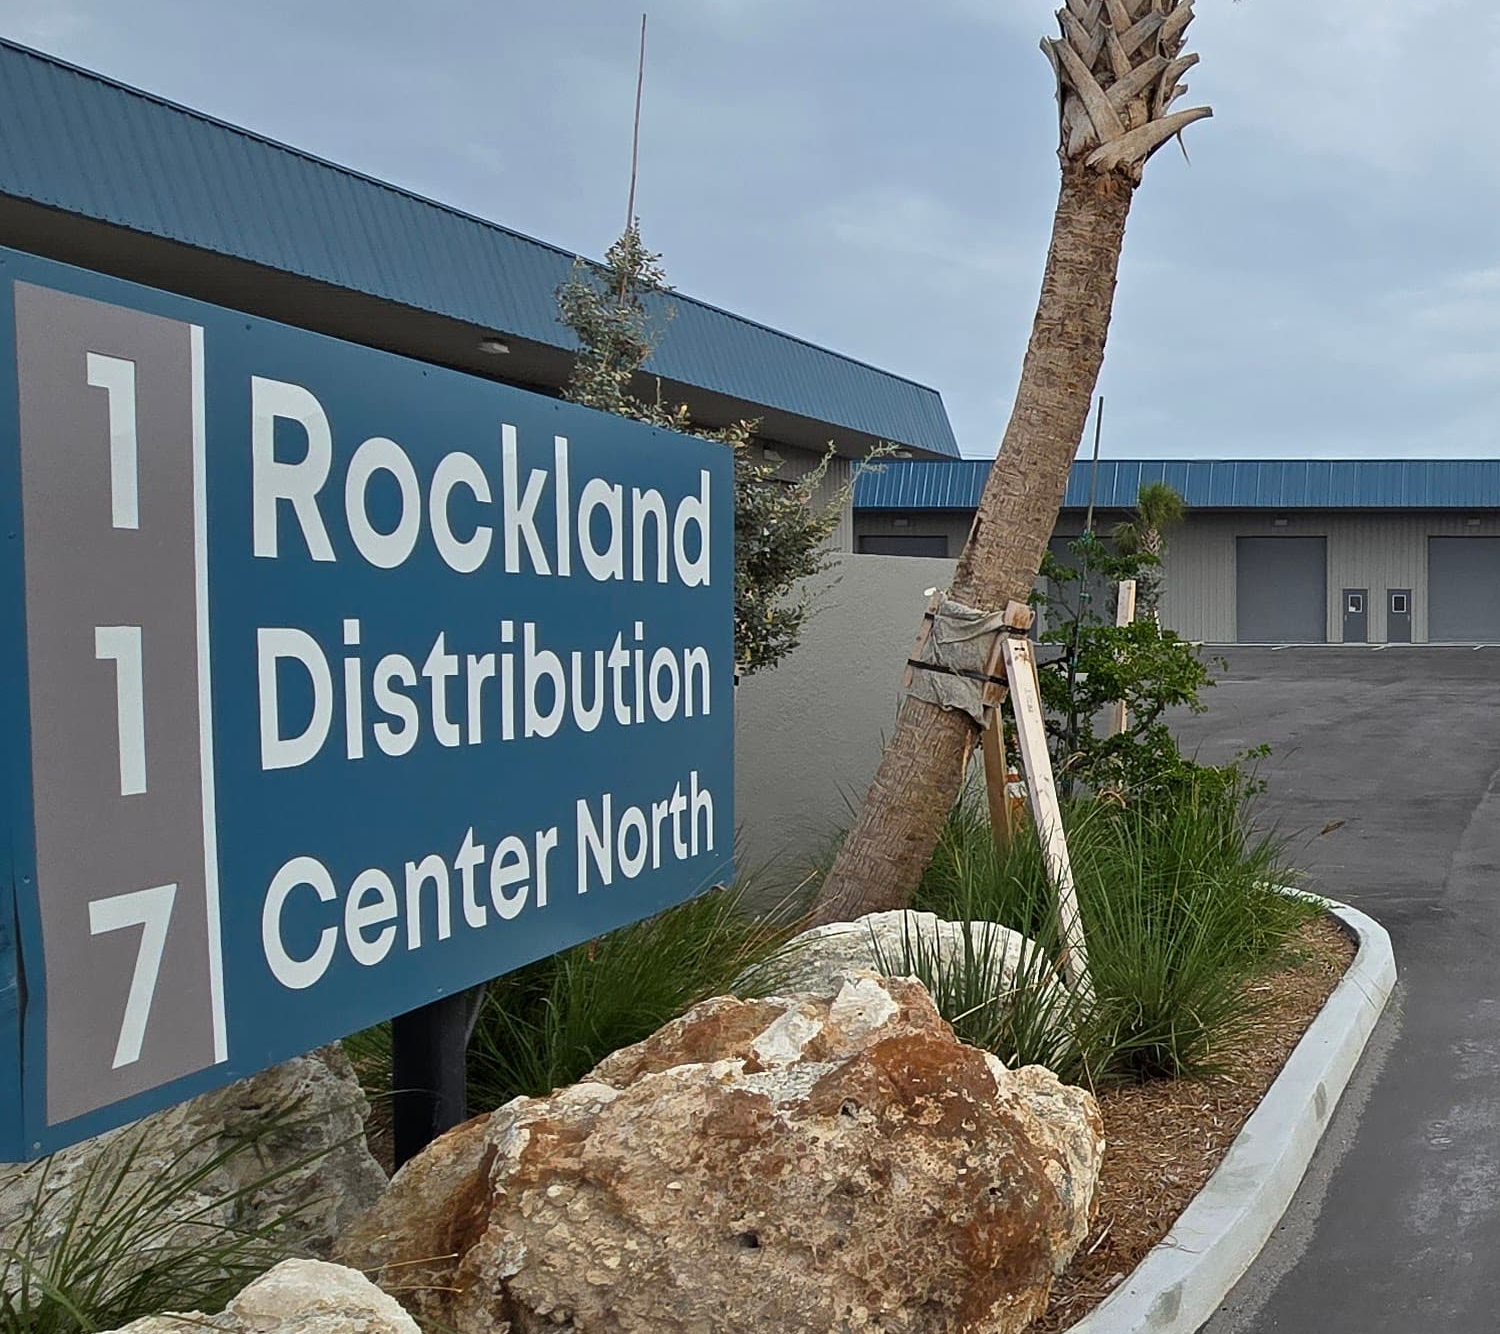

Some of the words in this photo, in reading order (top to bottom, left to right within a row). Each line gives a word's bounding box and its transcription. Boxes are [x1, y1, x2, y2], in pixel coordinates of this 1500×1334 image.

[251, 376, 710, 587] Rockland
[257, 619, 710, 770] Distribution
[262, 826, 559, 989] Center
[577, 771, 714, 894] North
